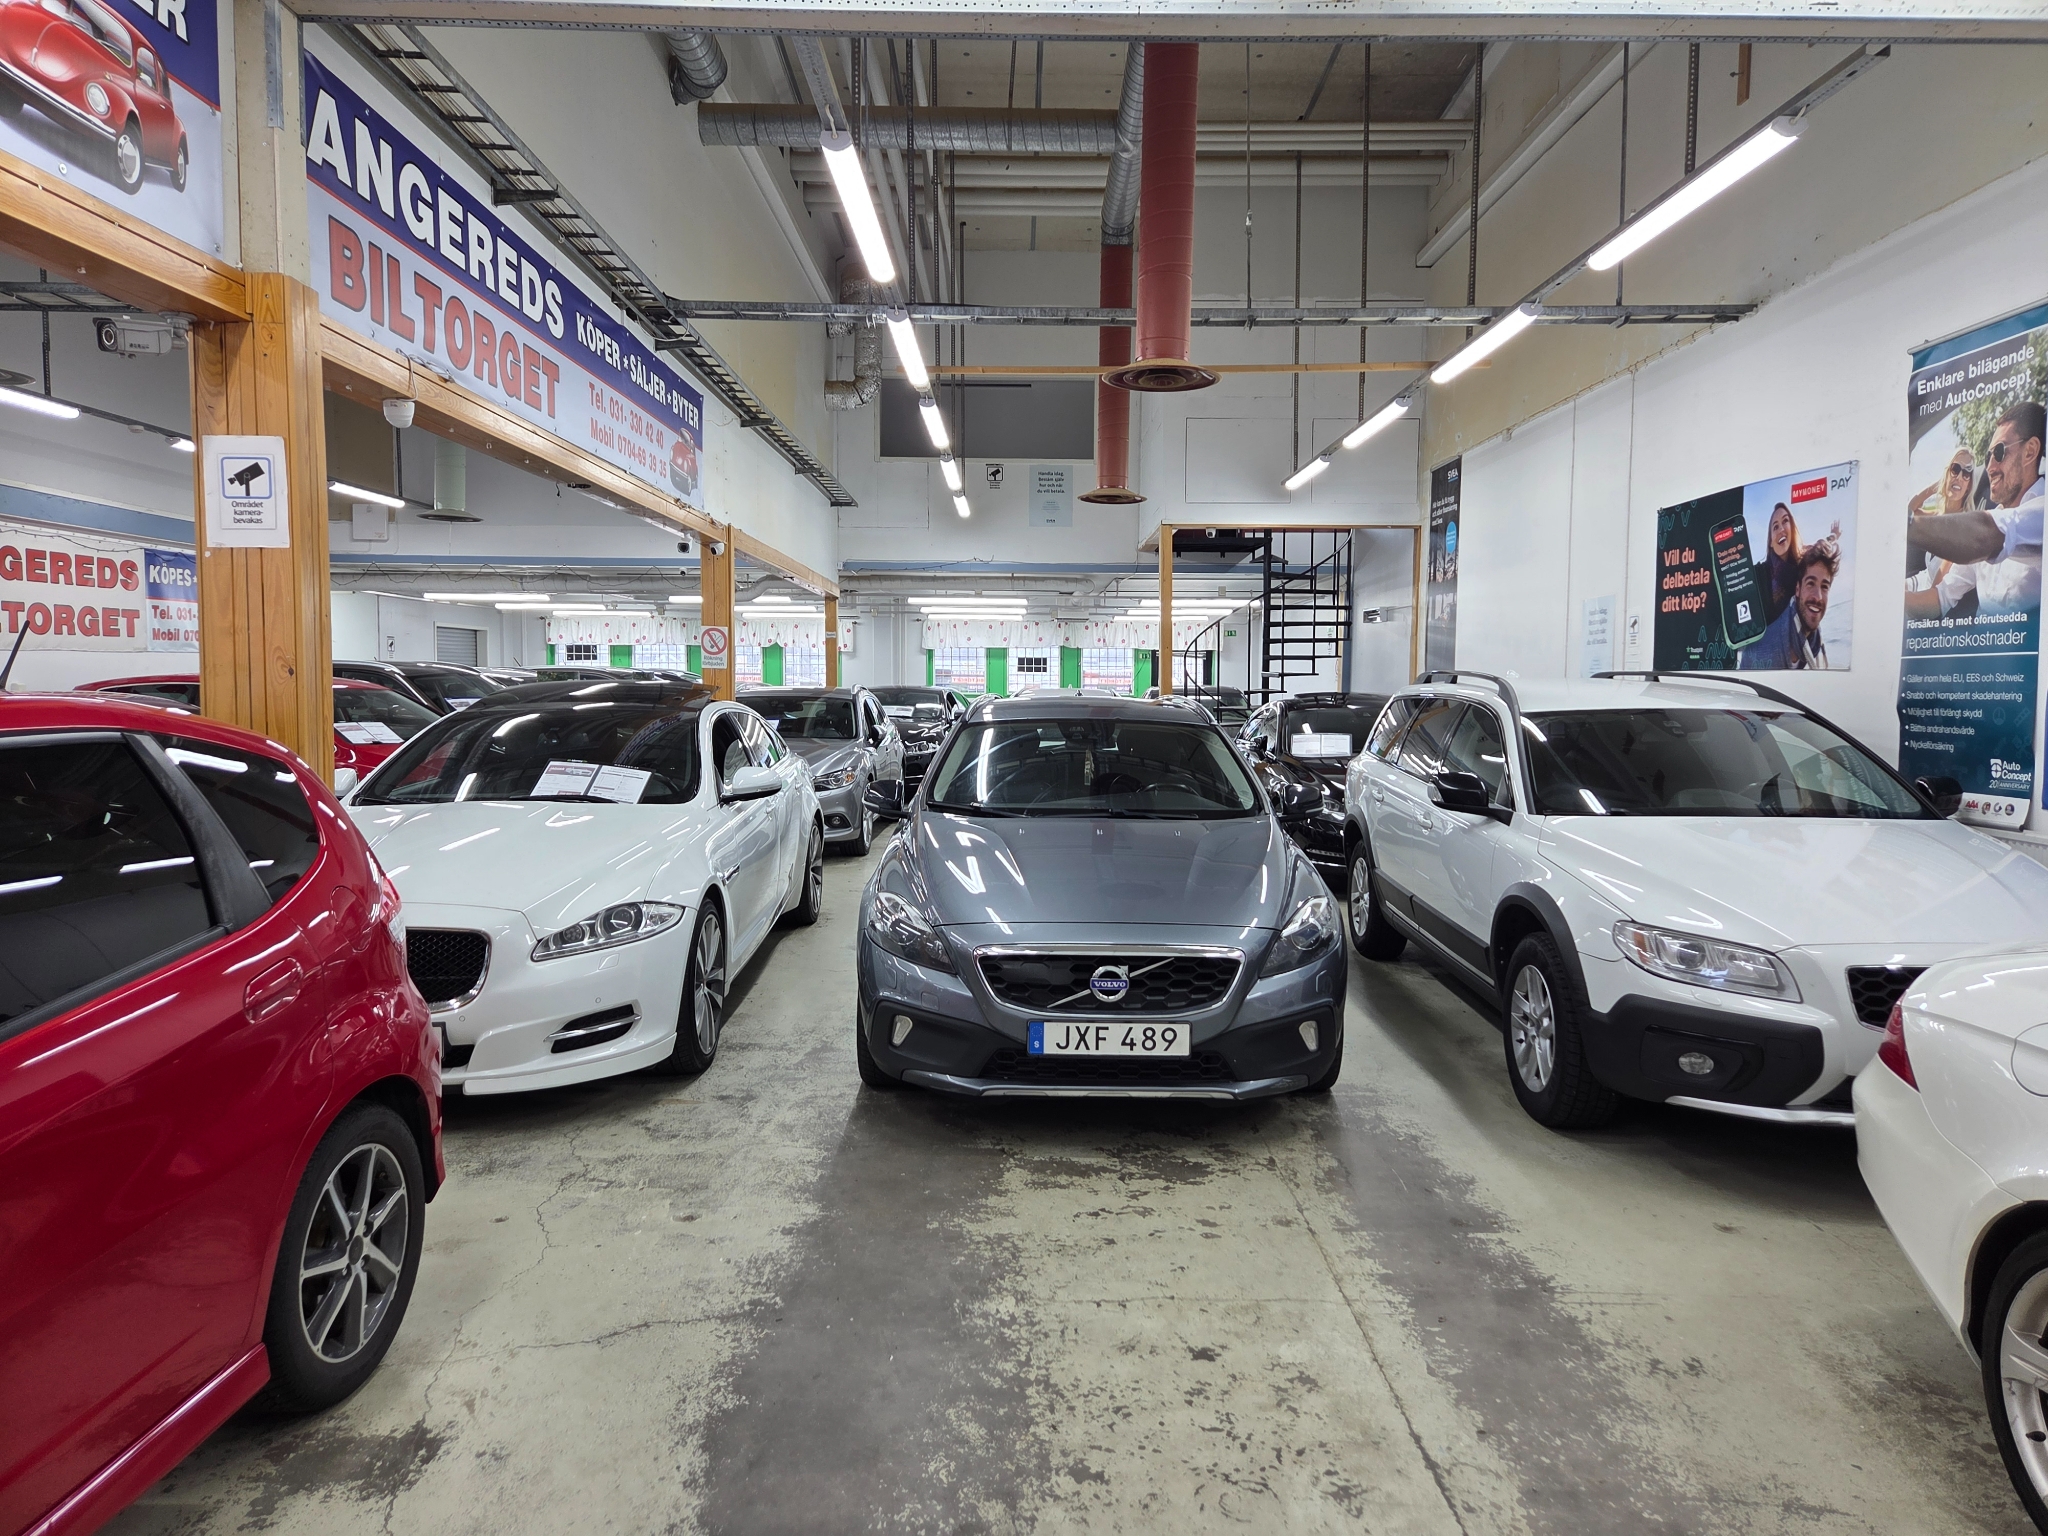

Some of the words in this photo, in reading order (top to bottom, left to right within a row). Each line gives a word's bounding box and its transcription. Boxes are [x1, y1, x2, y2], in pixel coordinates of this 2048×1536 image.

[306, 88, 565, 340] ANGEREDS
[328, 214, 560, 420] BILTORGET
[575, 311, 622, 372] KÖPER
[629, 354, 667, 407] SÄLJER
[672, 389, 699, 431] BYTER
[1917, 370, 1965, 396] Enklare
[1968, 345, 2035, 380] bilägande
[1919, 396, 1942, 417] med
[1944, 368, 2032, 409] AutoConcept
[588, 381, 606, 414] Tel.
[609, 396, 627, 425] 031-
[629, 409, 643, 437] 330
[645, 422, 655, 444] 42
[655, 429, 665, 451] 40
[590, 417, 615, 450] Mobil
[617, 433, 647, 468] 0704-69
[648, 452, 657, 475] 39
[658, 458, 668, 479] 35
[1792, 483, 1826, 499] MYMONEY
[1830, 476, 1852, 491] PAY
[231, 500, 264, 508] Området
[232, 516, 264, 524] bevakas
[1663, 548, 1680, 567] Vill
[1681, 547, 1696, 564] du
[149, 563, 193, 587] KÖPES
[1662, 568, 1711, 590] delbetala
[151, 605, 173, 620] Tel.
[1661, 594, 1681, 613] ditt
[1681, 591, 1707, 613] köp?
[1906, 618, 1940, 630] Försäkra
[1941, 616, 1954, 629] dig
[1955, 615, 1973, 626] mot
[1973, 611, 2028, 625] oförutsedda
[152, 628, 180, 641] Mobil
[1905, 629, 2027, 652] reparationskostnader
[1939, 673, 1952, 682] hela
[1952, 673, 1965, 684] EU,
[1966, 673, 1981, 683] EES
[1982, 673, 1994, 682] och
[1994, 672, 2025, 682] Schweiz
[1906, 690, 1925, 700] Snabb
[1925, 691, 1937, 700] och
[1937, 691, 1971, 701] kompetent
[1971, 691, 2023, 703] skadehantering
[1962, 709, 1983, 719] skydd
[2001, 770, 2032, 783] Concept
[2002, 761, 2021, 771] Auto
[1033, 1040, 1040, 1049] S
[1055, 1025, 1110, 1051] JXF
[1120, 1026, 1178, 1052] 489
